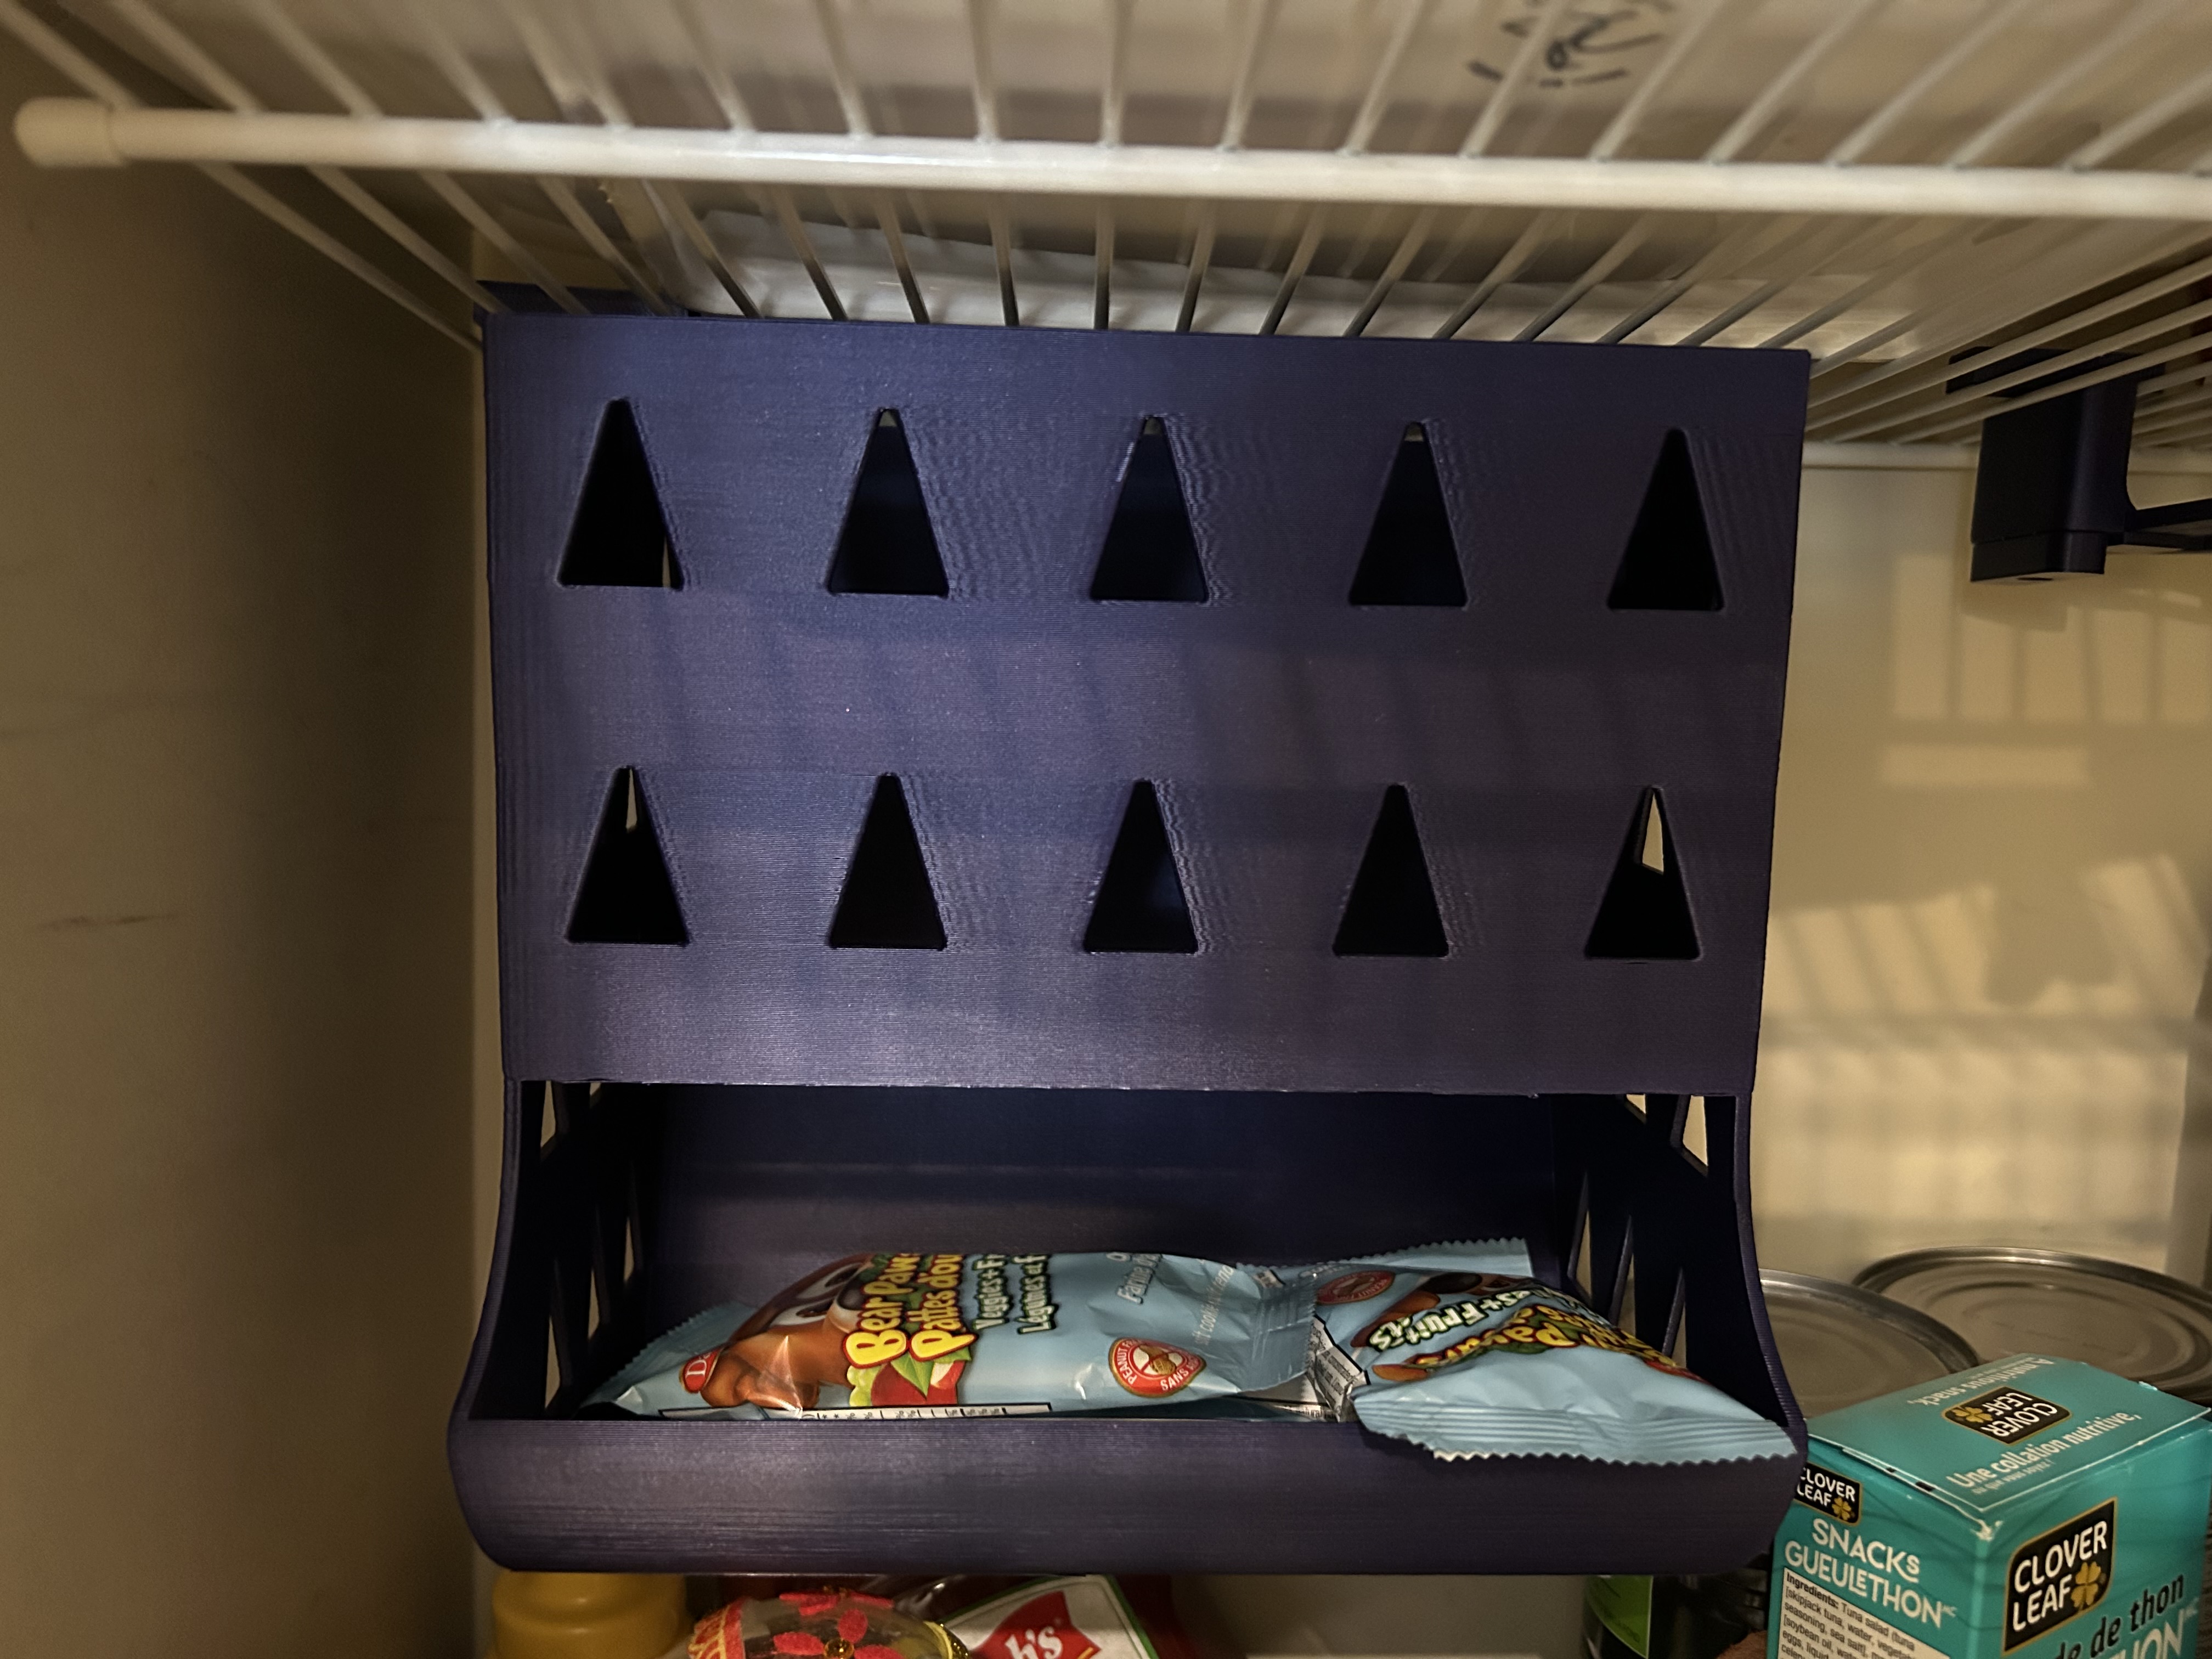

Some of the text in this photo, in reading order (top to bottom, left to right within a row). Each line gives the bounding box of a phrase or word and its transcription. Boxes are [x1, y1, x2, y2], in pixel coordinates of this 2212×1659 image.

[845, 1254, 921, 1364] Bear Paw
[907, 1254, 975, 1358] Pattes d'ou
[975, 1278, 1009, 1330] Veggies
[1018, 1275, 1054, 1333] Légumes
[1116, 1347, 1137, 1385] PEANUT
[1160, 1368, 1189, 1391] SANS
[1961, 1363, 2038, 1389] nutritious
[1981, 1402, 2058, 1437] CLOVER
[1982, 1392, 2033, 1416] LEAF
[1945, 1412, 2142, 1487] Une collation nutritive,
[1797, 1483, 1832, 1507] LEAF
[1812, 1517, 1920, 1584] SNACKS
[2014, 1520, 2108, 1593] CLOVER
[1785, 1540, 1942, 1630] GUEULETHON
[1786, 1571, 1839, 1609] Ingredients:
[1842, 1602, 1863, 1623] Tuna
[1865, 1618, 1889, 1637] salad
[2012, 1573, 2073, 1632] LEAF
[1782, 1629, 1804, 1651] eggs,
[1783, 1613, 1820, 1644] [soybean
[1784, 1601, 1827, 1635] seasoning,
[1830, 1628, 1845, 1643] sea
[1786, 1585, 1822, 1615] [skipjack
[1824, 1608, 1844, 1629] tuna,
[1847, 1623, 1875, 1645] water,
[2090, 1616, 2121, 1658] de
[2130, 1574, 2183, 1632] thon
